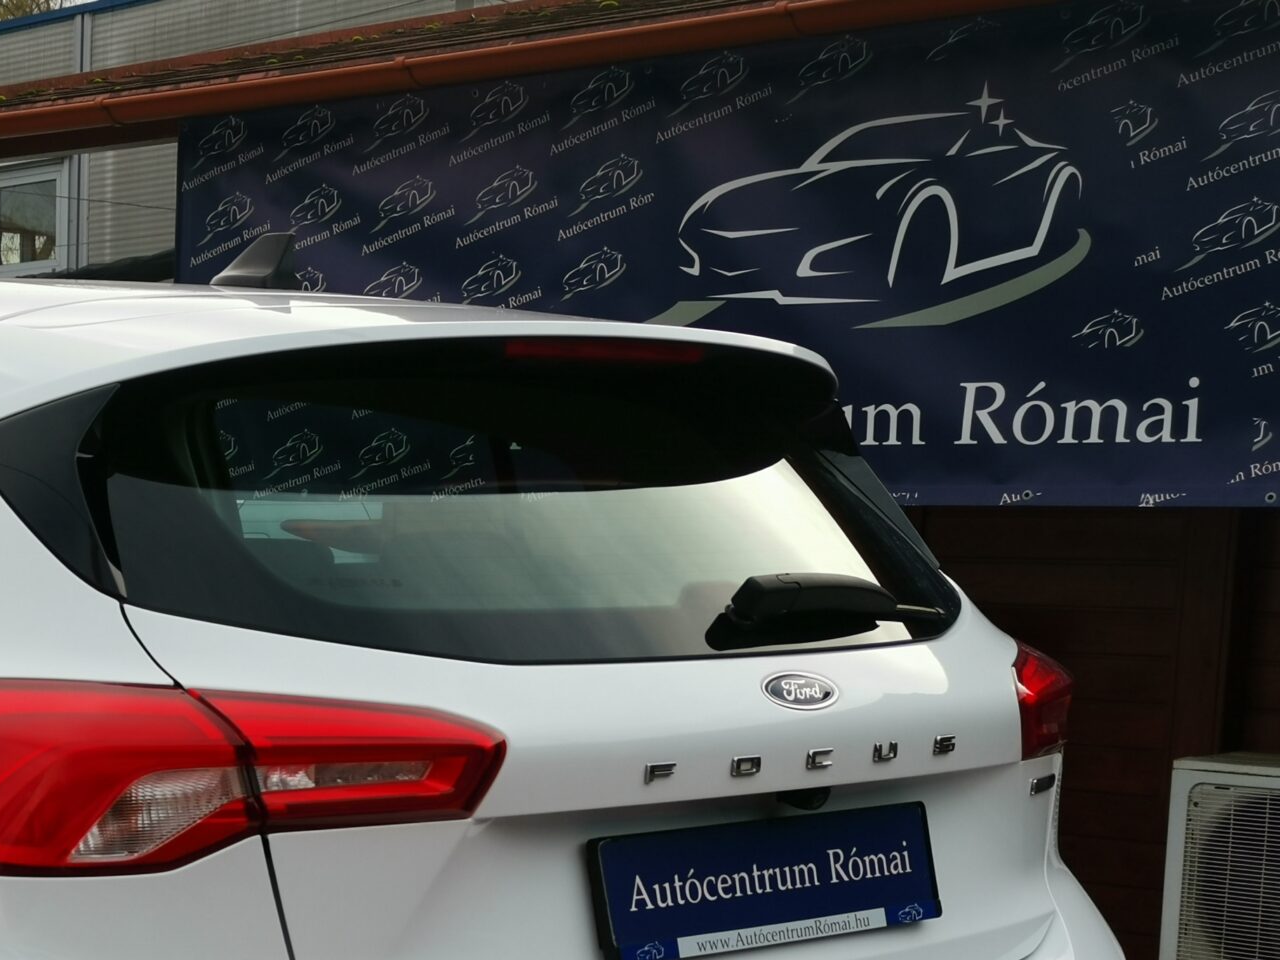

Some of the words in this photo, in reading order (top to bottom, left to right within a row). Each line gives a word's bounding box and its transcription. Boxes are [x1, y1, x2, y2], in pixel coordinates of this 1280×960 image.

[1130, 33, 1181, 64] Római
[448, 130, 515, 167] Autócentrum
[518, 110, 551, 135] Római
[549, 118, 619, 156] Autócentrum
[621, 96, 657, 123] Római
[655, 105, 733, 144] Autócentrum
[735, 83, 773, 110] Római
[181, 160, 236, 193] Autócentrum
[238, 144, 265, 166] Római
[265, 151, 321, 185] Autócentrum
[323, 133, 354, 156] Római
[352, 142, 416, 176] Autócentrum
[419, 123, 450, 146] Római
[1138, 136, 1188, 166] Római
[189, 237, 242, 268] Autócentrum
[243, 220, 271, 241] Római
[294, 230, 331, 251] entrum
[332, 212, 361, 236] Római
[361, 222, 421, 256] Autócentrum
[423, 204, 455, 227] Római
[455, 214, 521, 249] Autócentrum
[524, 195, 559, 220] Római
[557, 205, 627, 242] Autócentrum
[505, 286, 542, 310] Római
[1161, 258, 1261, 301] Autócentrum
[953, 376, 1203, 446] Római
[781, 679, 823, 702] Ford
[644, 733, 957, 785] FOCUS
[629, 859, 820, 912] Autócentrum
[827, 840, 913, 884] Római
[696, 912, 871, 953] www.AutócentrumRómai.hu
